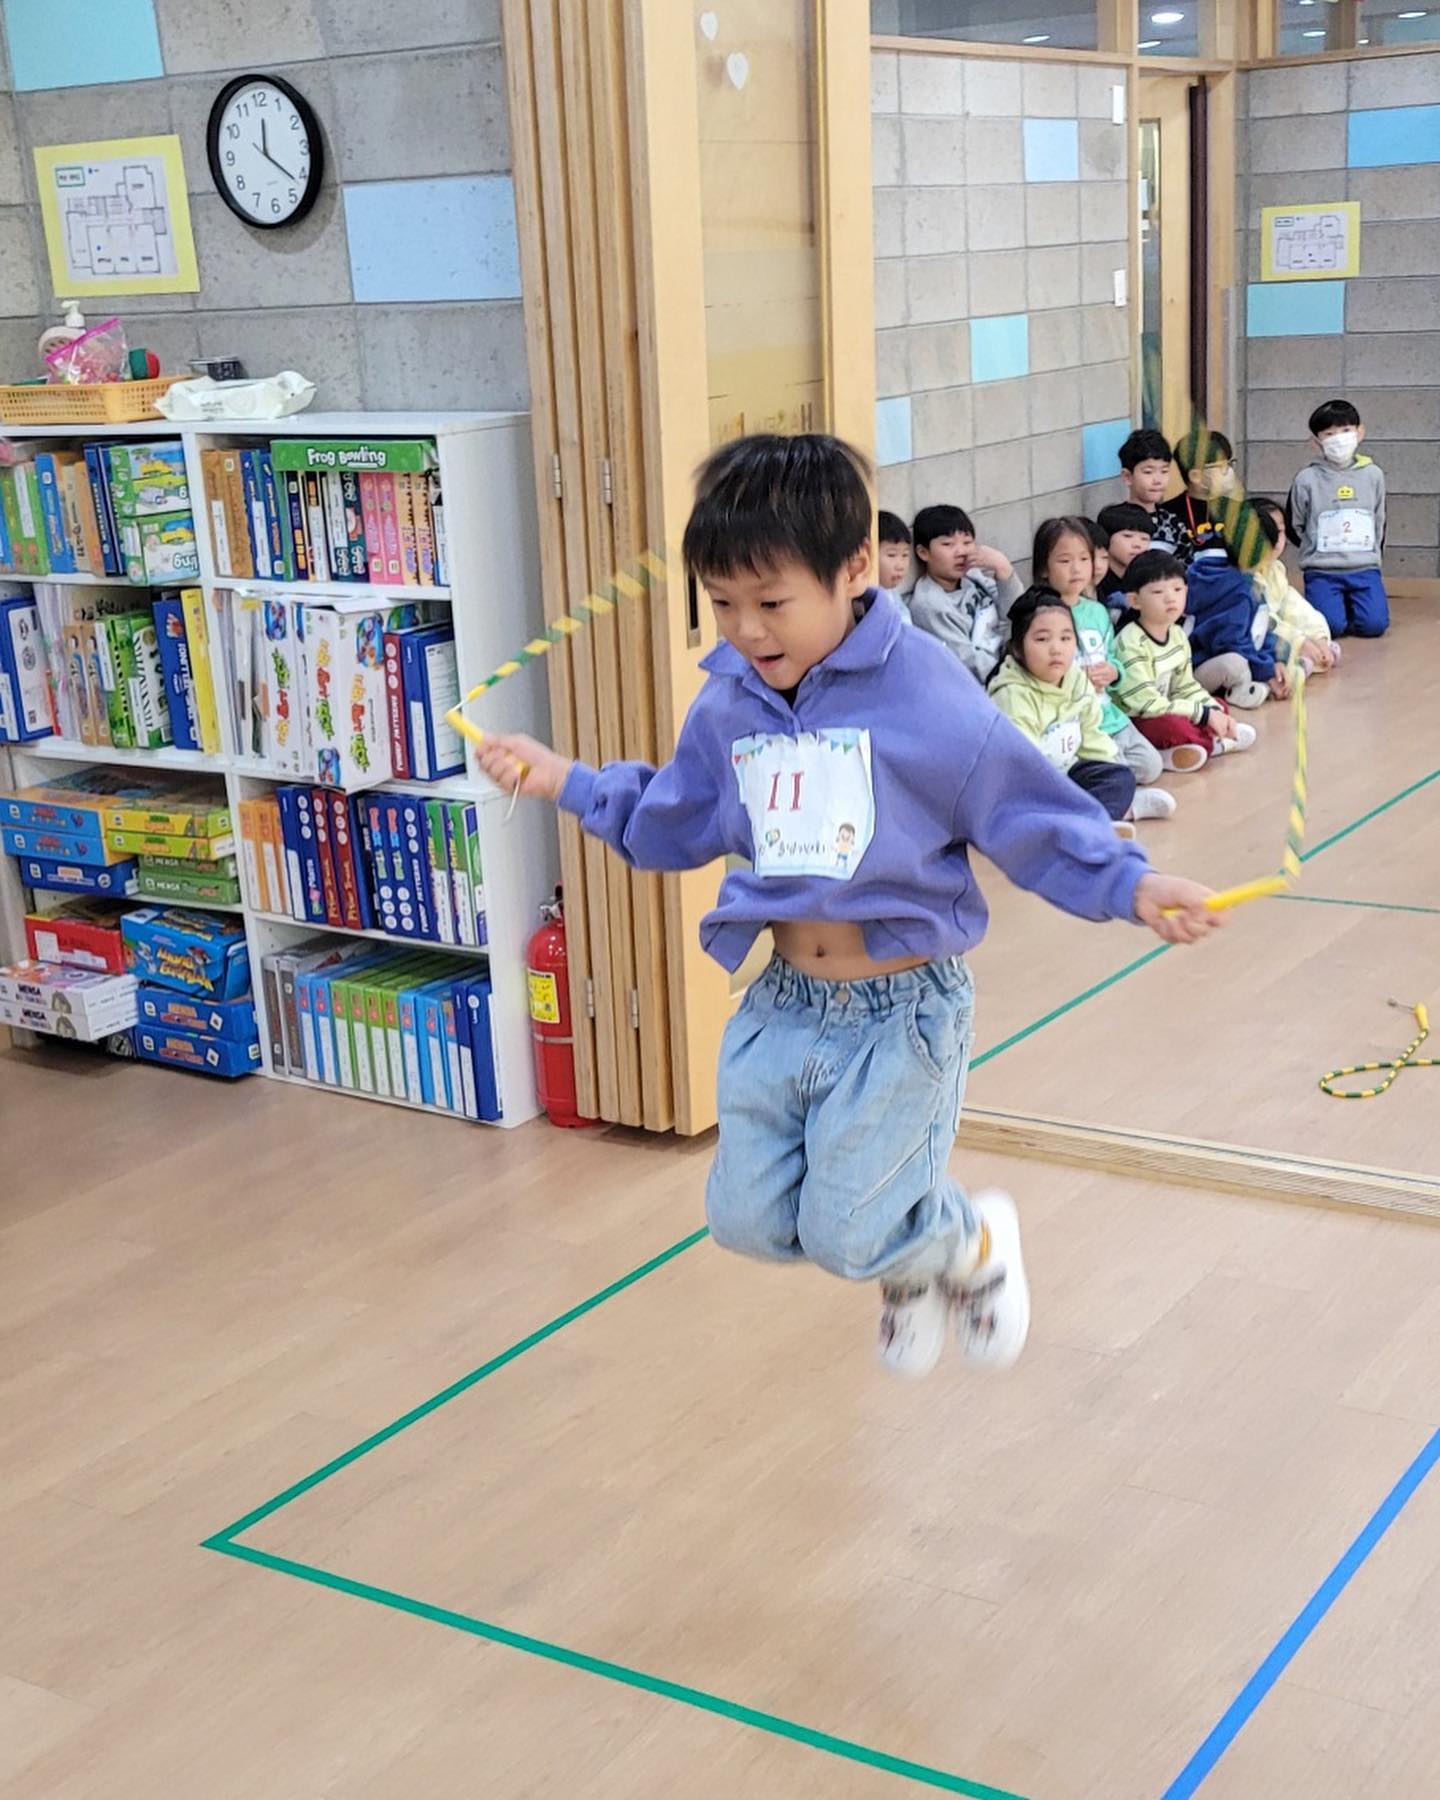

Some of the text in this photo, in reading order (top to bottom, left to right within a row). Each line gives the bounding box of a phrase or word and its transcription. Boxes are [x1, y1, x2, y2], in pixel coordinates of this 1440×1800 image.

[252, 91, 267, 107] 12
[275, 98, 282, 112] 1
[236, 103, 249, 118] 11
[290, 115, 299, 130] 2
[226, 123, 240, 139] 10
[299, 139, 309, 156] 3
[226, 150, 235, 166] 9
[299, 166, 307, 179] 4
[236, 175, 245, 190] 8
[252, 192, 261, 208] 7
[288, 188, 298, 203] 5
[271, 198, 280, 214] 6
[307, 446, 386, 467] Frog Bowling
[1343, 521, 1352, 534] 2
[767, 771, 805, 812] 11
